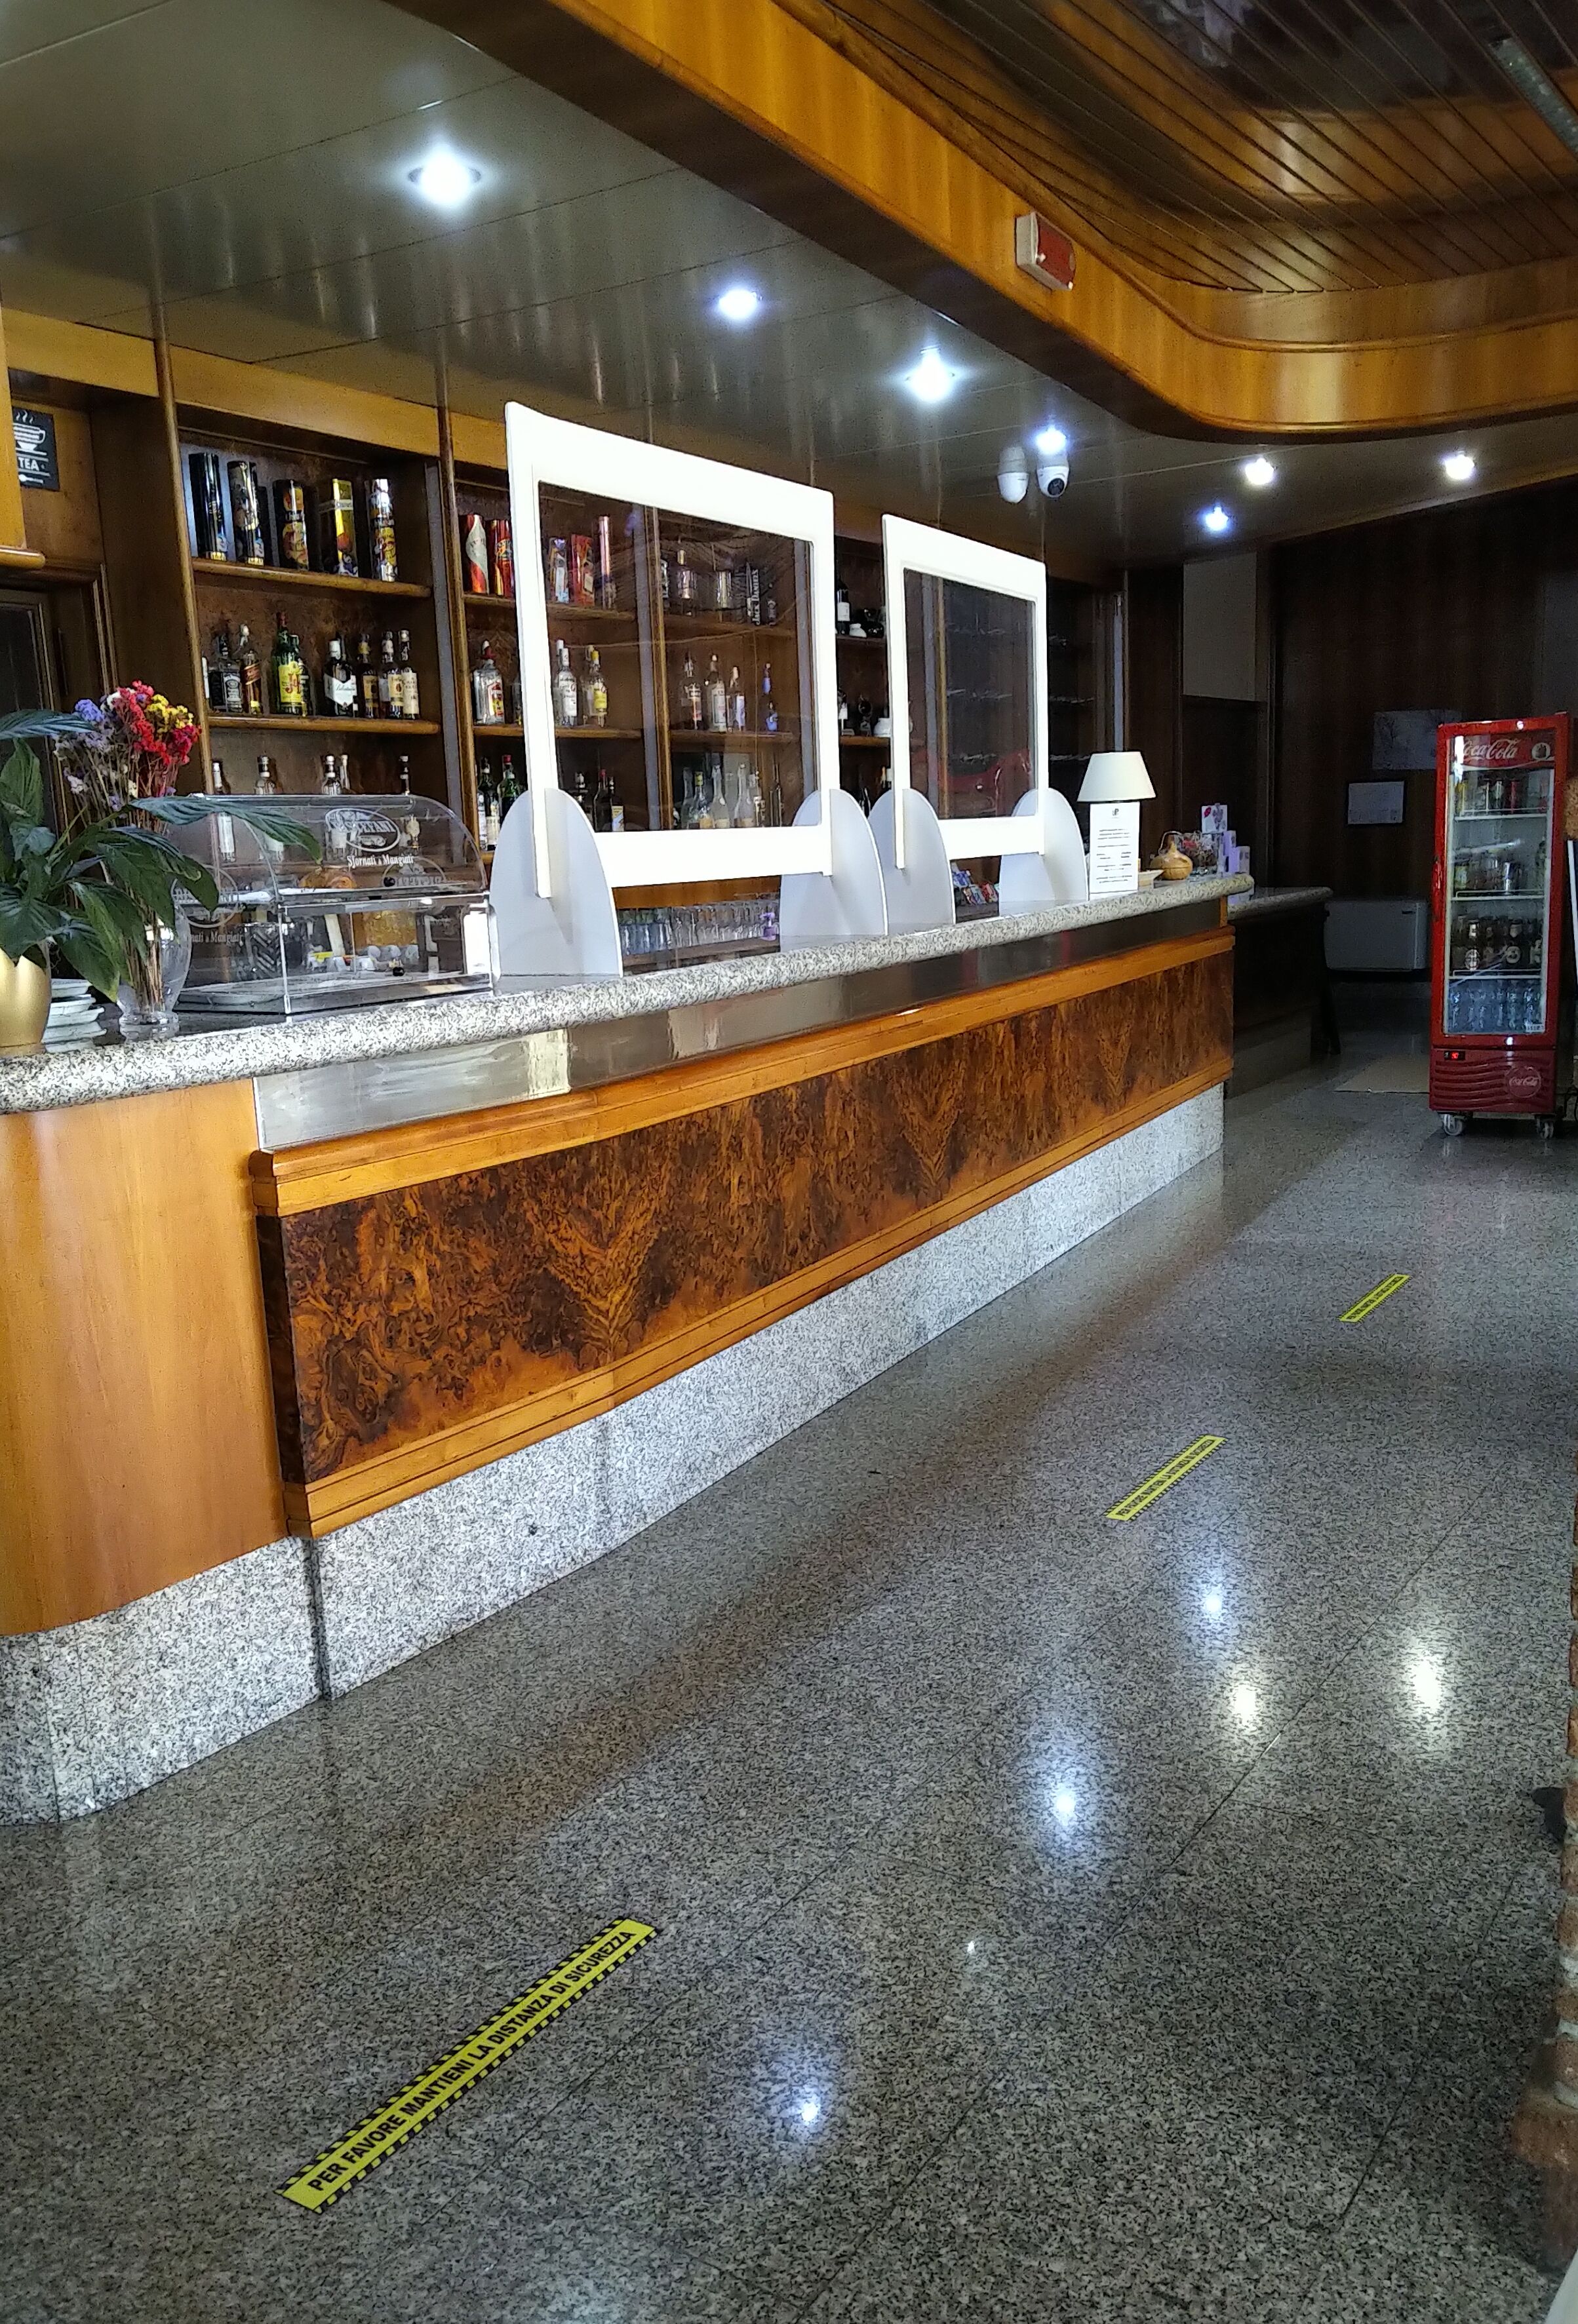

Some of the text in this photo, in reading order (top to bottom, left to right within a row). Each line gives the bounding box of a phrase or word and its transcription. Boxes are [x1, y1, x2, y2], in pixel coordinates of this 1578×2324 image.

[18, 457, 39, 471] TEA
[307, 1931, 637, 2191] PER FAVORE MANTIENI LA DISTANZA DI SICUREZZA
